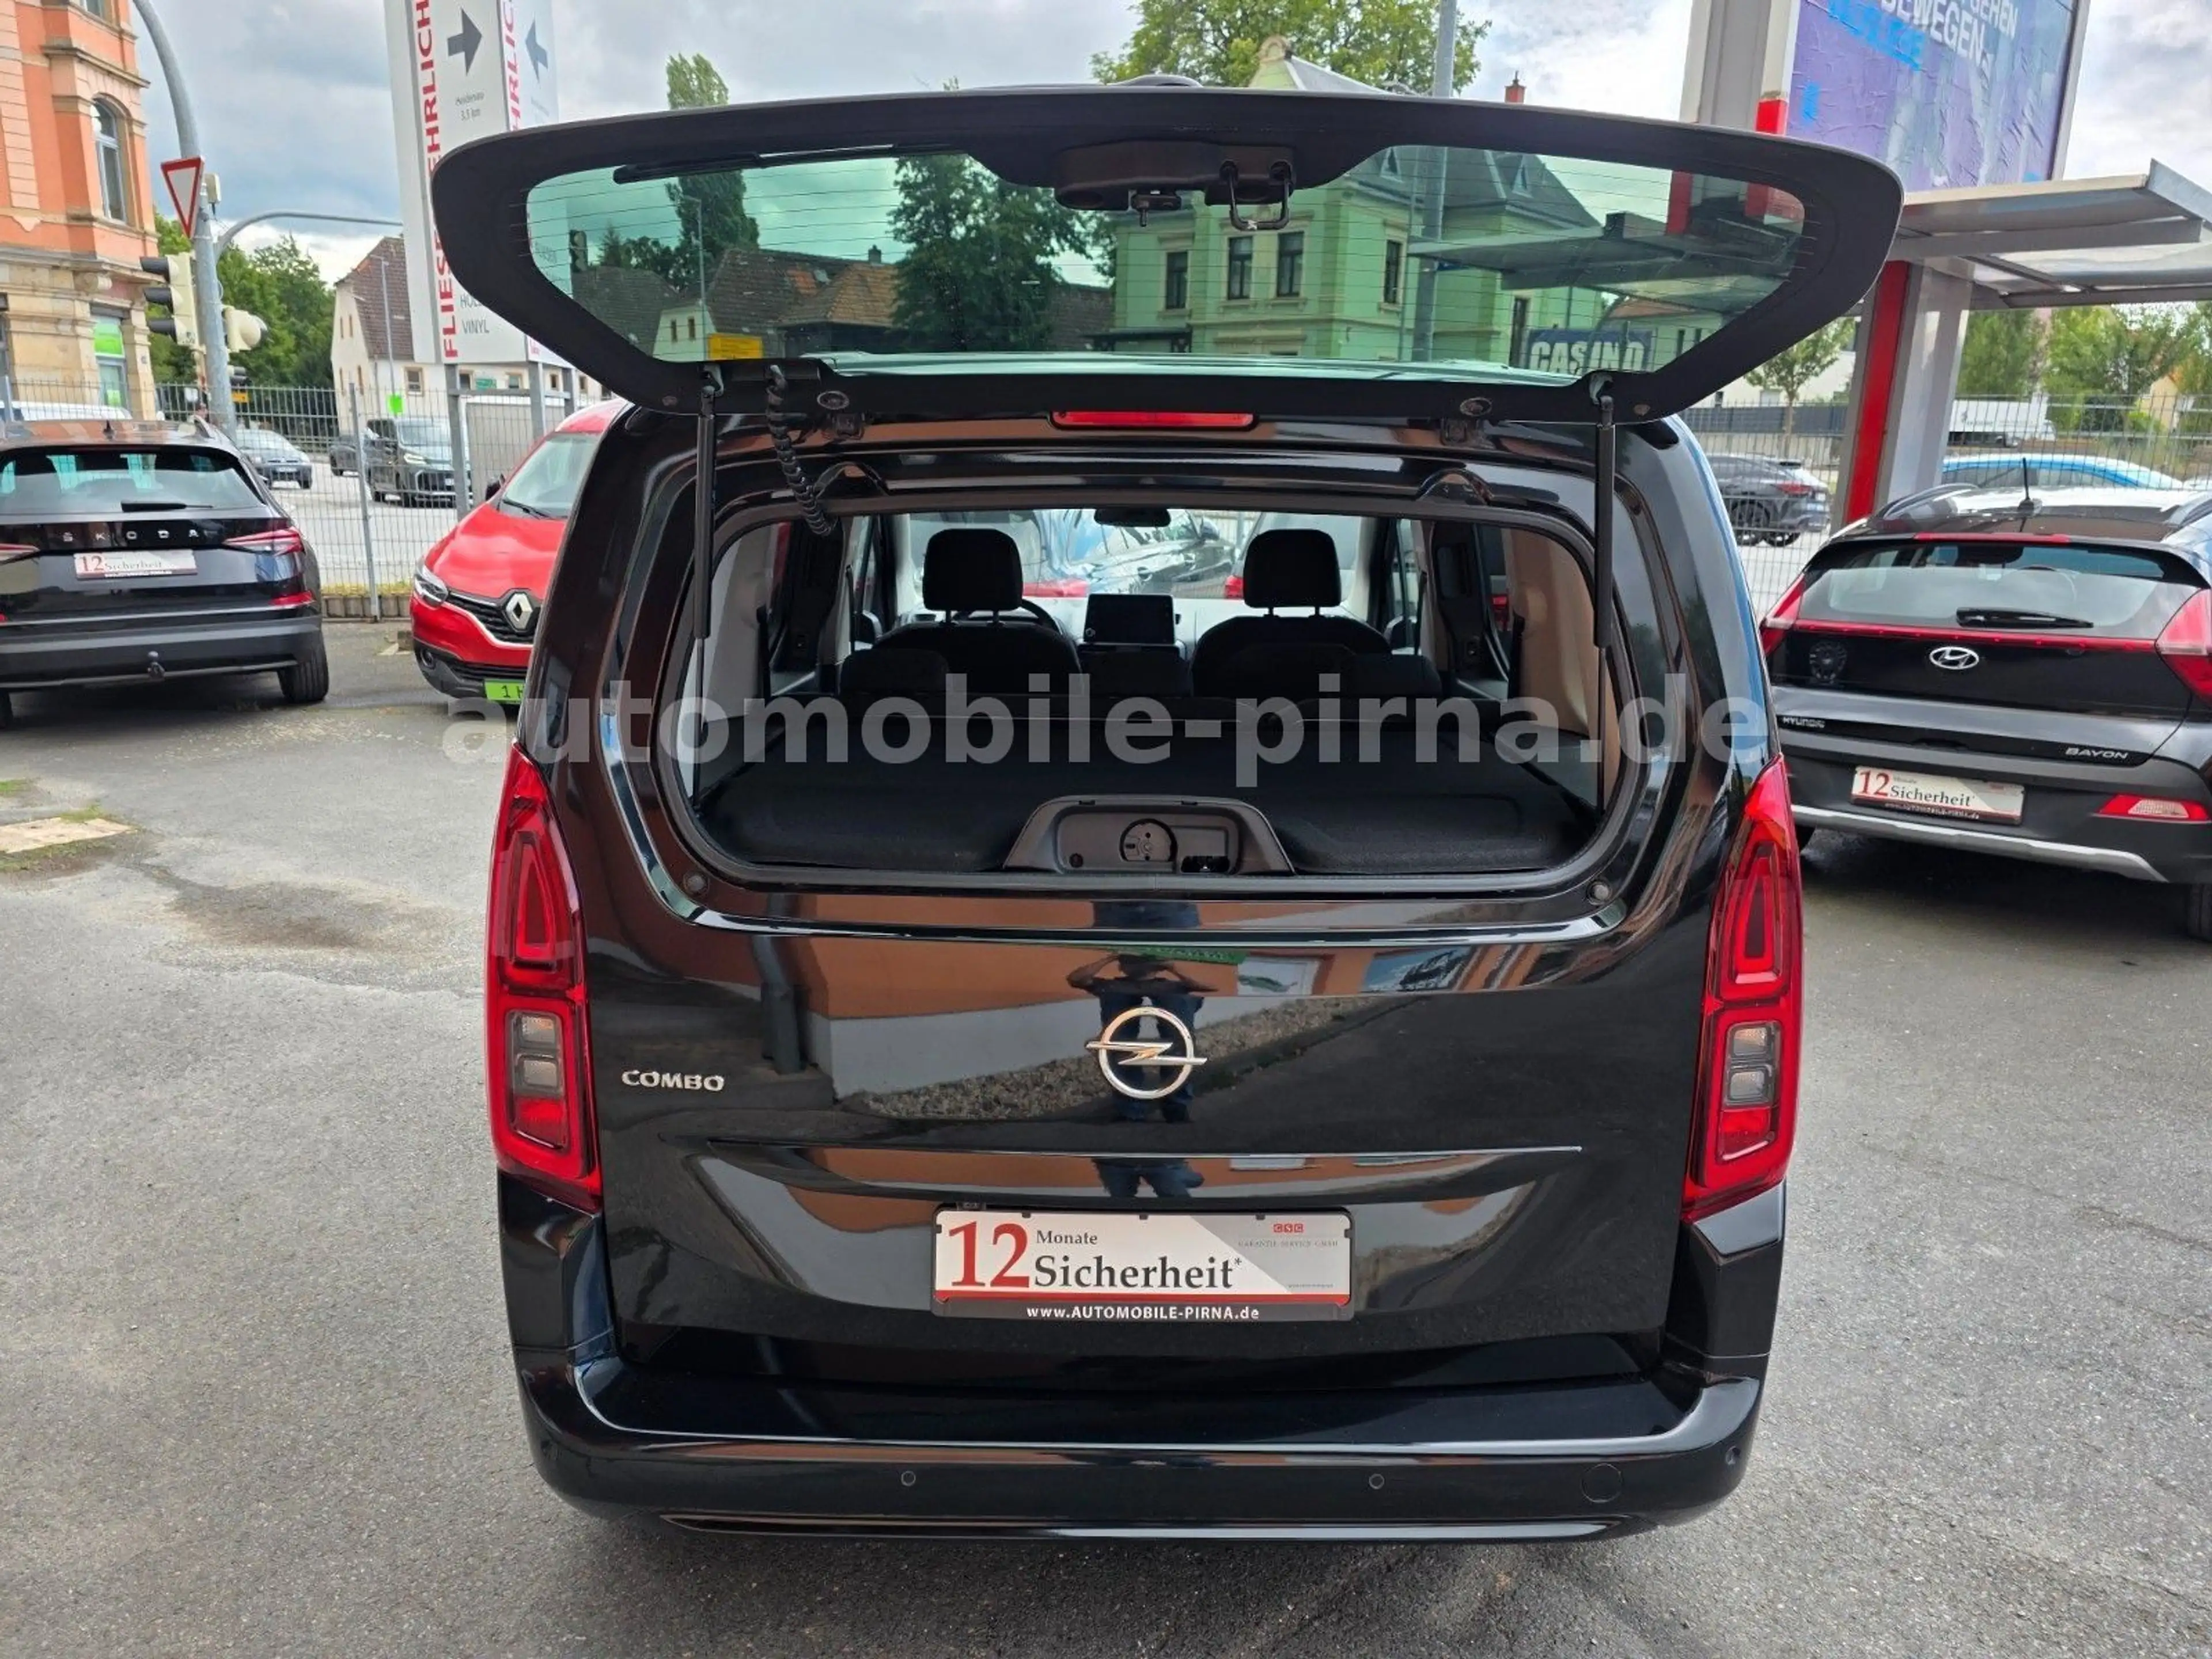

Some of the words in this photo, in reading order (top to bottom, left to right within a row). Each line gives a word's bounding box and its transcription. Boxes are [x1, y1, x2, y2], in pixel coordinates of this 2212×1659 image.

[461, 319, 490, 334] VINYL
[1529, 340, 1645, 374] CASINO
[81, 555, 104, 572] 12
[2066, 747, 2128, 760] BAYON
[1860, 770, 1890, 797] 12
[622, 1070, 725, 1092] COMBO
[1037, 1230, 1098, 1245] Monate
[948, 1221, 1030, 1289] 12
[1027, 1305, 1260, 1320] www.AUTOMOBILE-PIRNA.de
